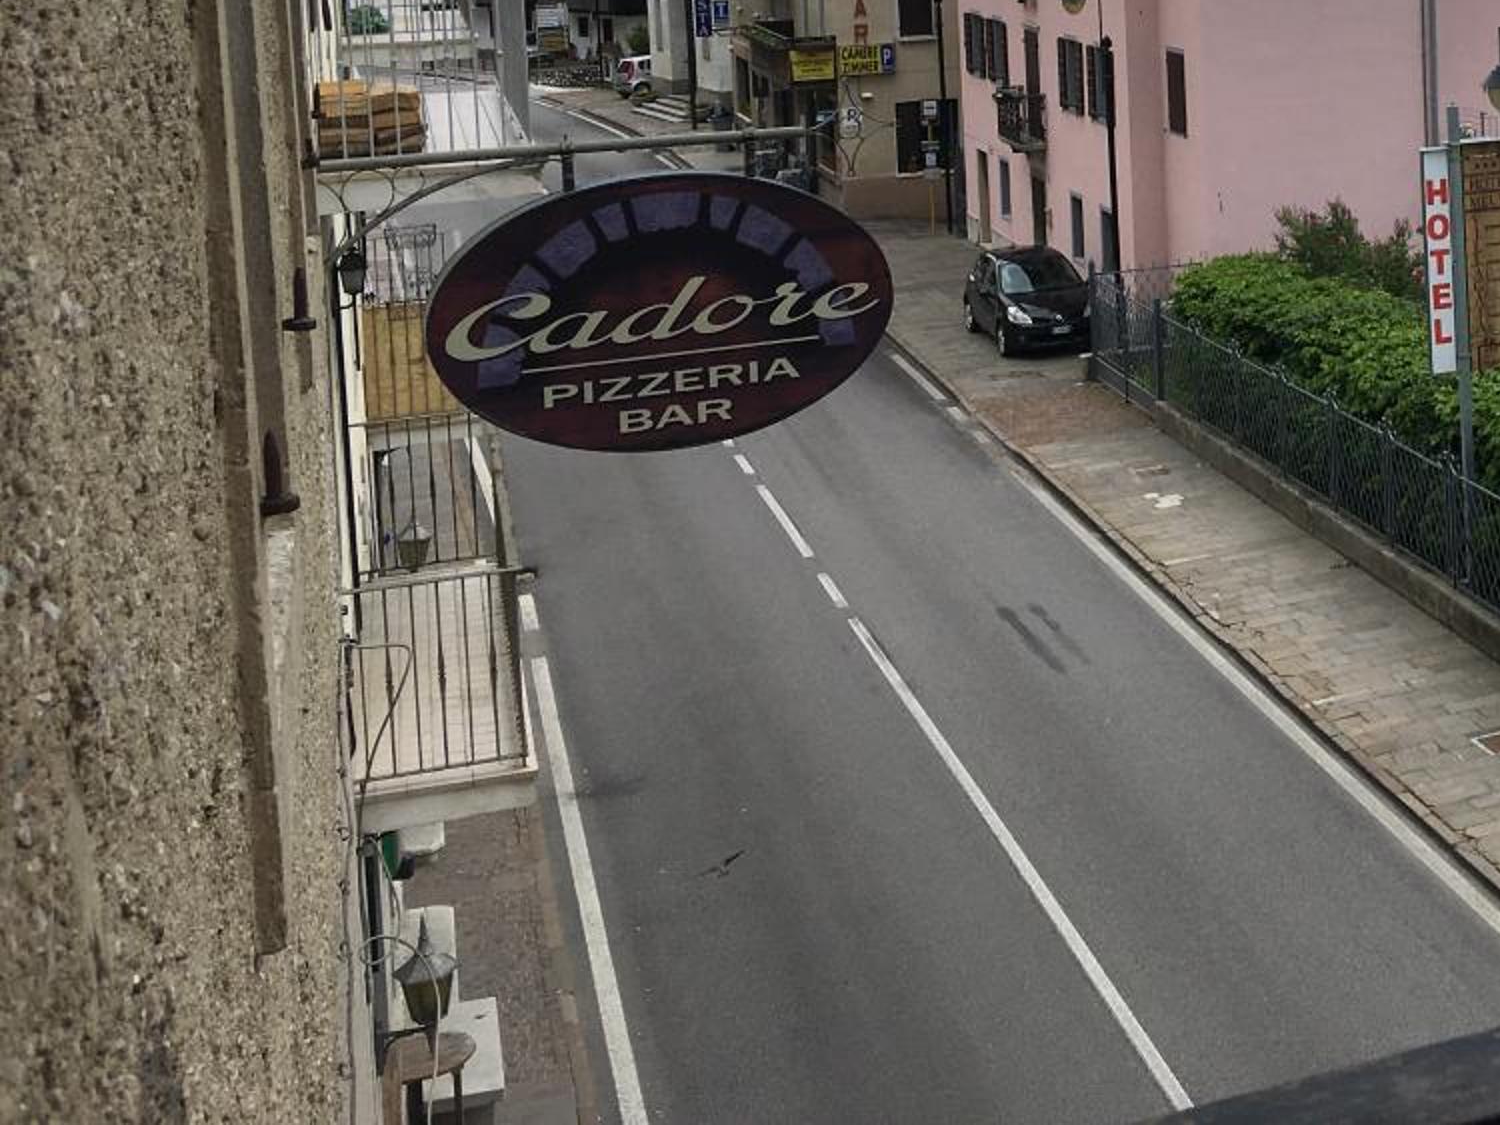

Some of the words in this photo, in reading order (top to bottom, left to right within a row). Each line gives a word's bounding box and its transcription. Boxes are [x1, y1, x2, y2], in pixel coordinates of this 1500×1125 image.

[841, 45, 878, 60] CAMERE
[841, 60, 879, 73] ZIMMER
[882, 47, 893, 65] P
[1426, 179, 1453, 347] HOTEL
[445, 276, 881, 363] Cadore
[543, 356, 801, 410] PIZZERIA
[618, 399, 735, 435] BAR
